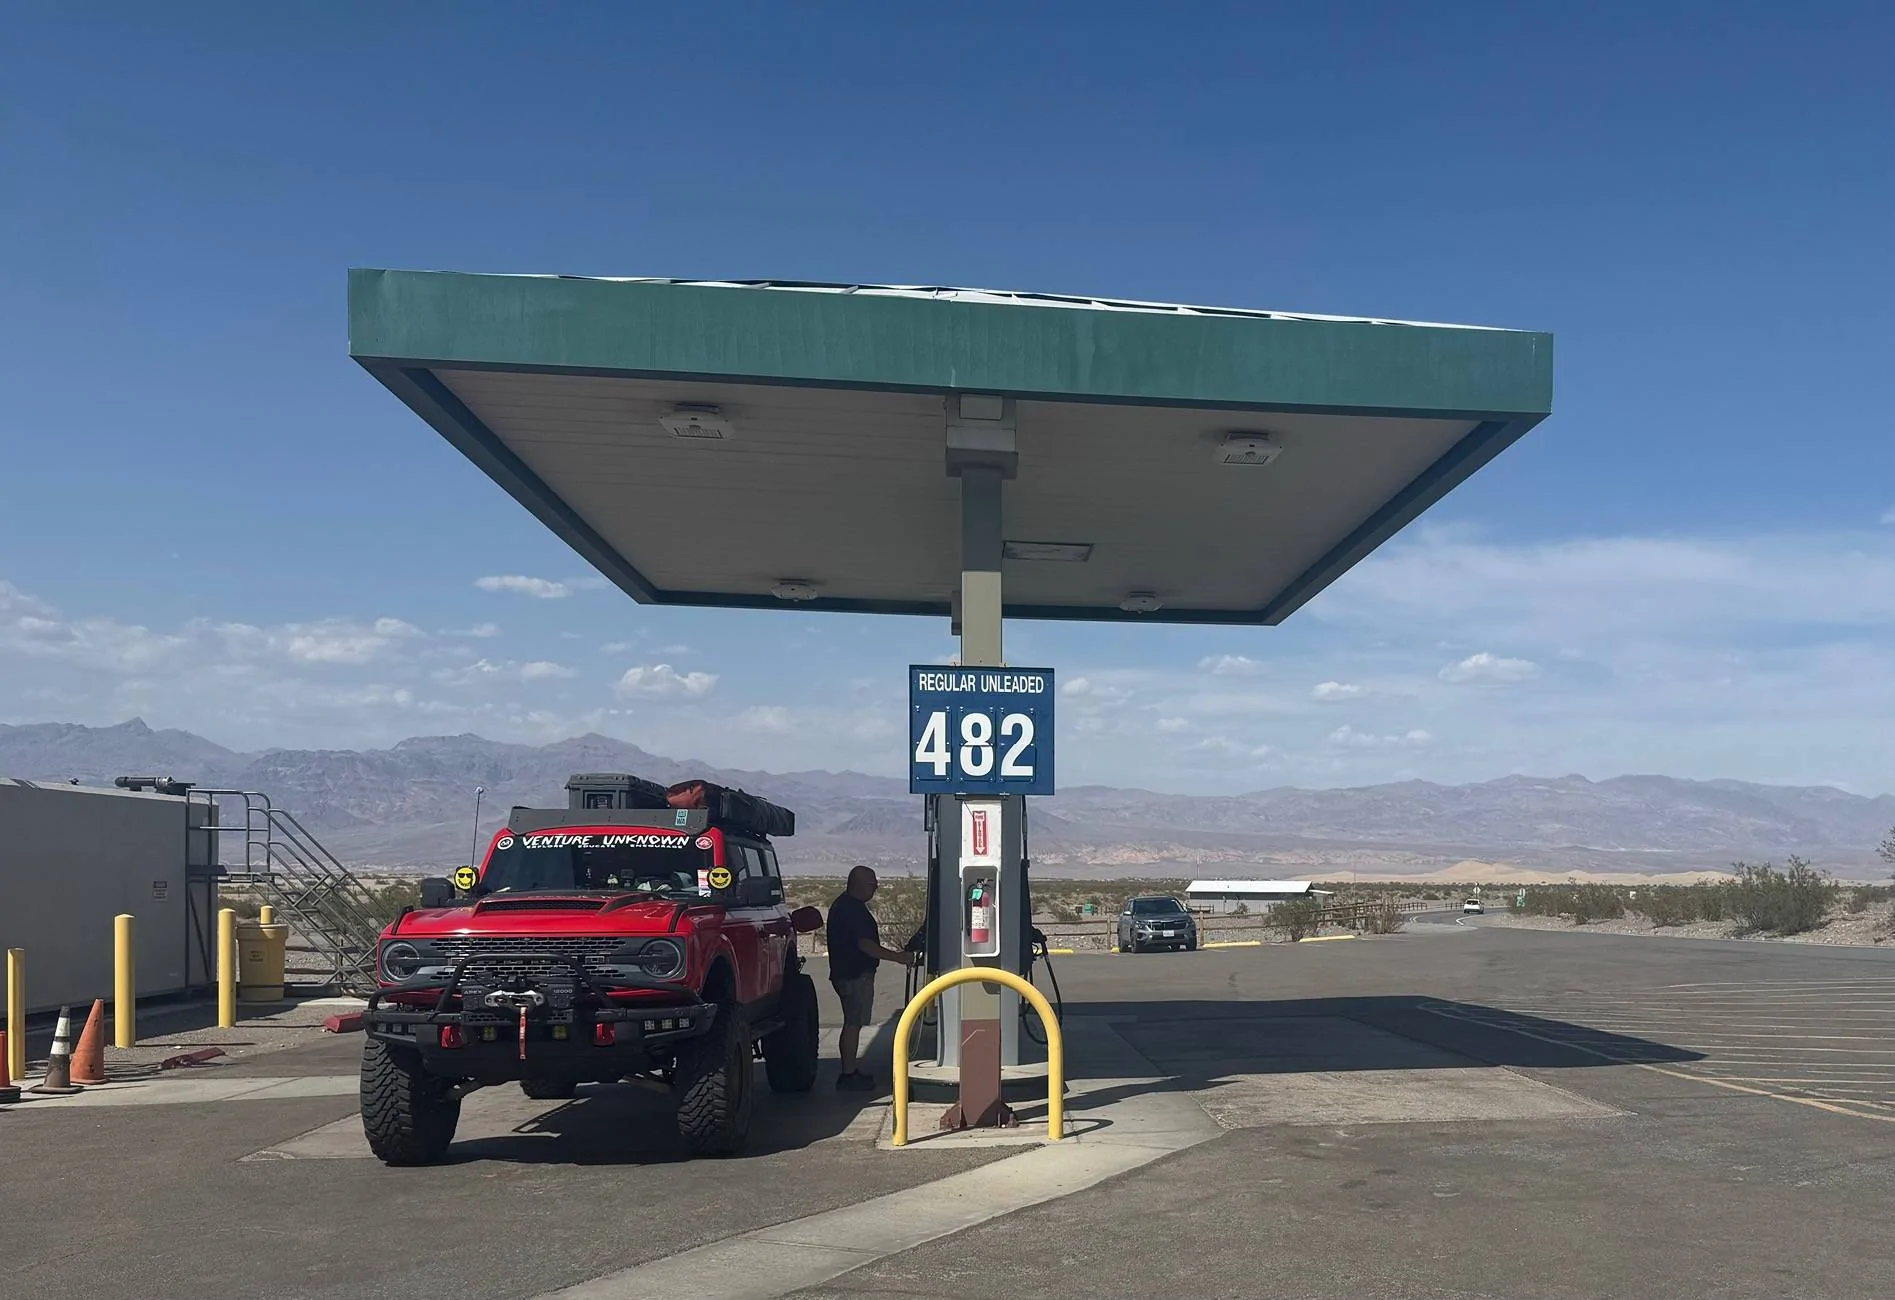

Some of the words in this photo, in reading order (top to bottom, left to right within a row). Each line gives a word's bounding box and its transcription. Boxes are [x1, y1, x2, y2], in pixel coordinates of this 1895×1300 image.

[919, 673, 976, 692] REGULAR
[981, 674, 1044, 694] UNLEADED
[915, 711, 1035, 777] 482
[522, 835, 593, 846] VENTURE
[603, 834, 690, 846] UNKNOWN
